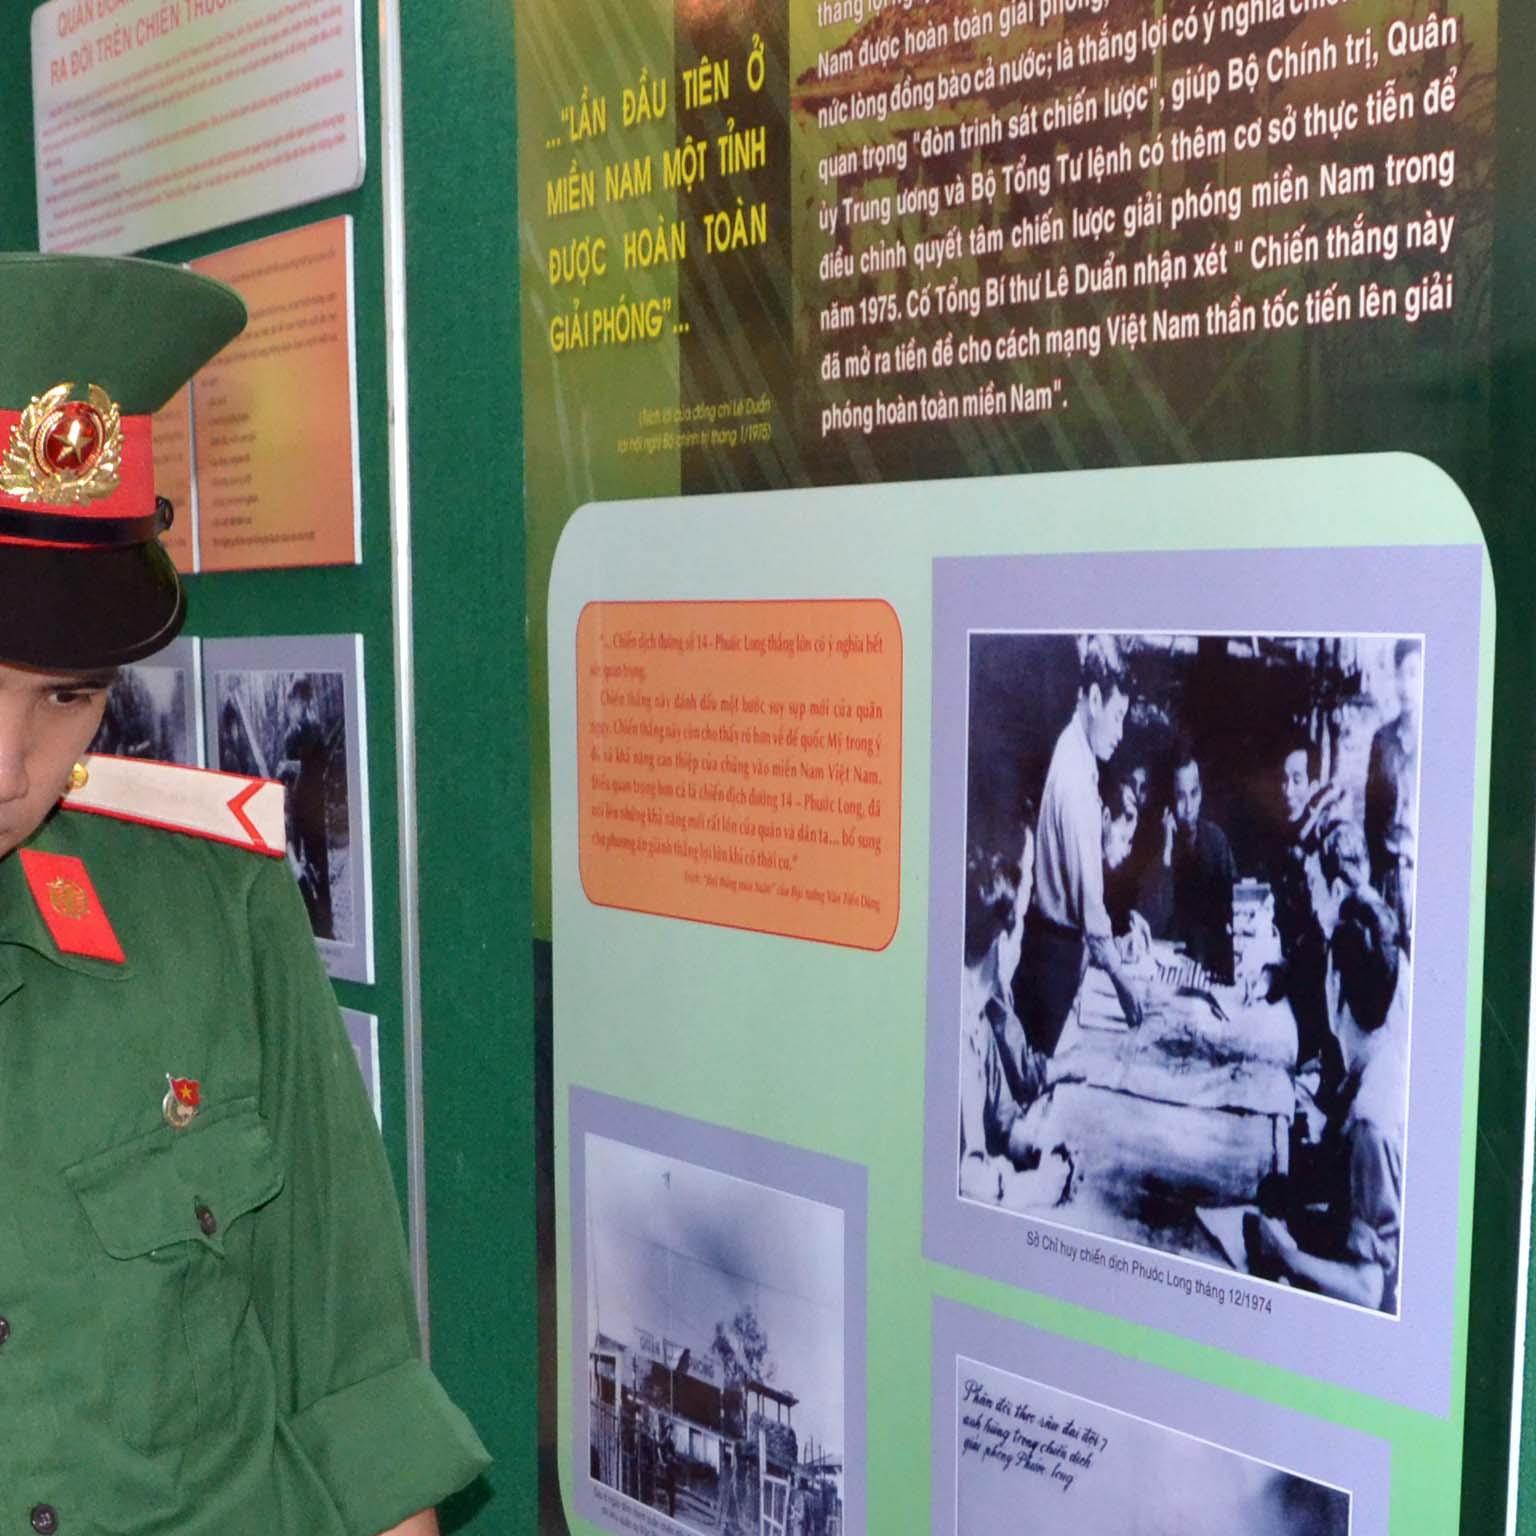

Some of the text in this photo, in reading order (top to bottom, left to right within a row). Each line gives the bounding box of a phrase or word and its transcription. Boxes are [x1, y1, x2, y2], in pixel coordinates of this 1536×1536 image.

[622, 33, 766, 130] ĐẦU TIÊN Ở
[817, 49, 853, 78] Nam
[858, 37, 900, 68] được
[905, 21, 947, 54] hoàn
[954, 9, 993, 44] toàn
[818, 1, 1215, 128] nức lòng đồng bào cả nước; là thắng lợi có ý
[819, 12, 1457, 185] quan trọng "đòn trinh sát chiến giúp Bộ Chính trị, Quân
[842, 66, 1457, 228] Trung ương và Bộ Tổng Tư lệnh có thêm cơ sở thực tiễn để
[546, 116, 767, 217] MIỀN NAM MỘT TỈNH
[819, 150, 1455, 280] điều chỉnh quyết tâm chiến lược giải phóng miền Nam trong
[549, 195, 767, 286] ĐƯỢC HOÀN TOÀN
[820, 209, 1455, 331] năm 1975. Cố Tổng Bí thư Lê Duẩn nhận xét Chiến thắng này
[550, 297, 591, 352] GIẢI
[820, 270, 1454, 381] đã mở ra tiền đề cho cách mạng Việt Nam thần tốc tiến lên giải
[822, 380, 1007, 437] phóng hoàn toàn miền
[1026, 1231, 1272, 1315] Sở Chỉ huy chiến dịch Phước Long tháng 12/1974
